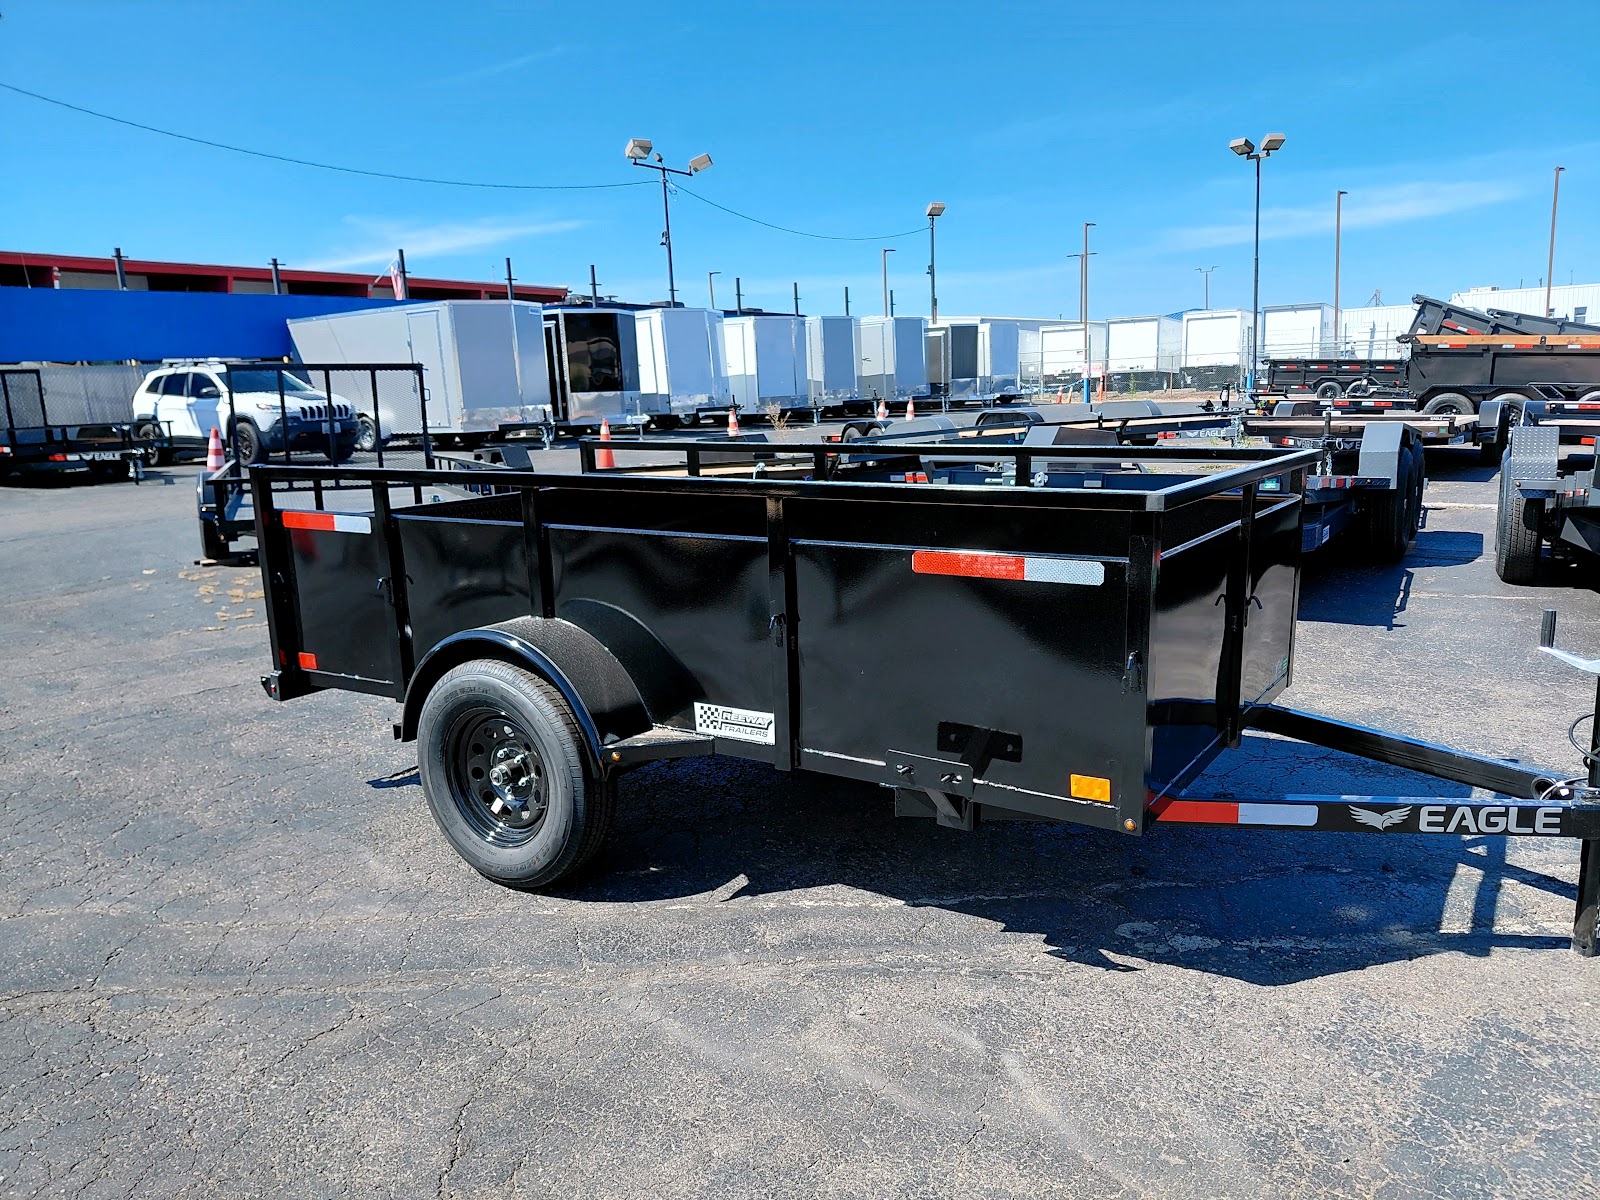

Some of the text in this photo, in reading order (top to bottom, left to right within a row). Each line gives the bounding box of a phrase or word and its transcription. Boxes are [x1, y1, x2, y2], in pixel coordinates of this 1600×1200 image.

[1200, 429, 1227, 438] EAGLE
[723, 725, 768, 738] TRAILERS
[1418, 805, 1563, 834] EAGLE
